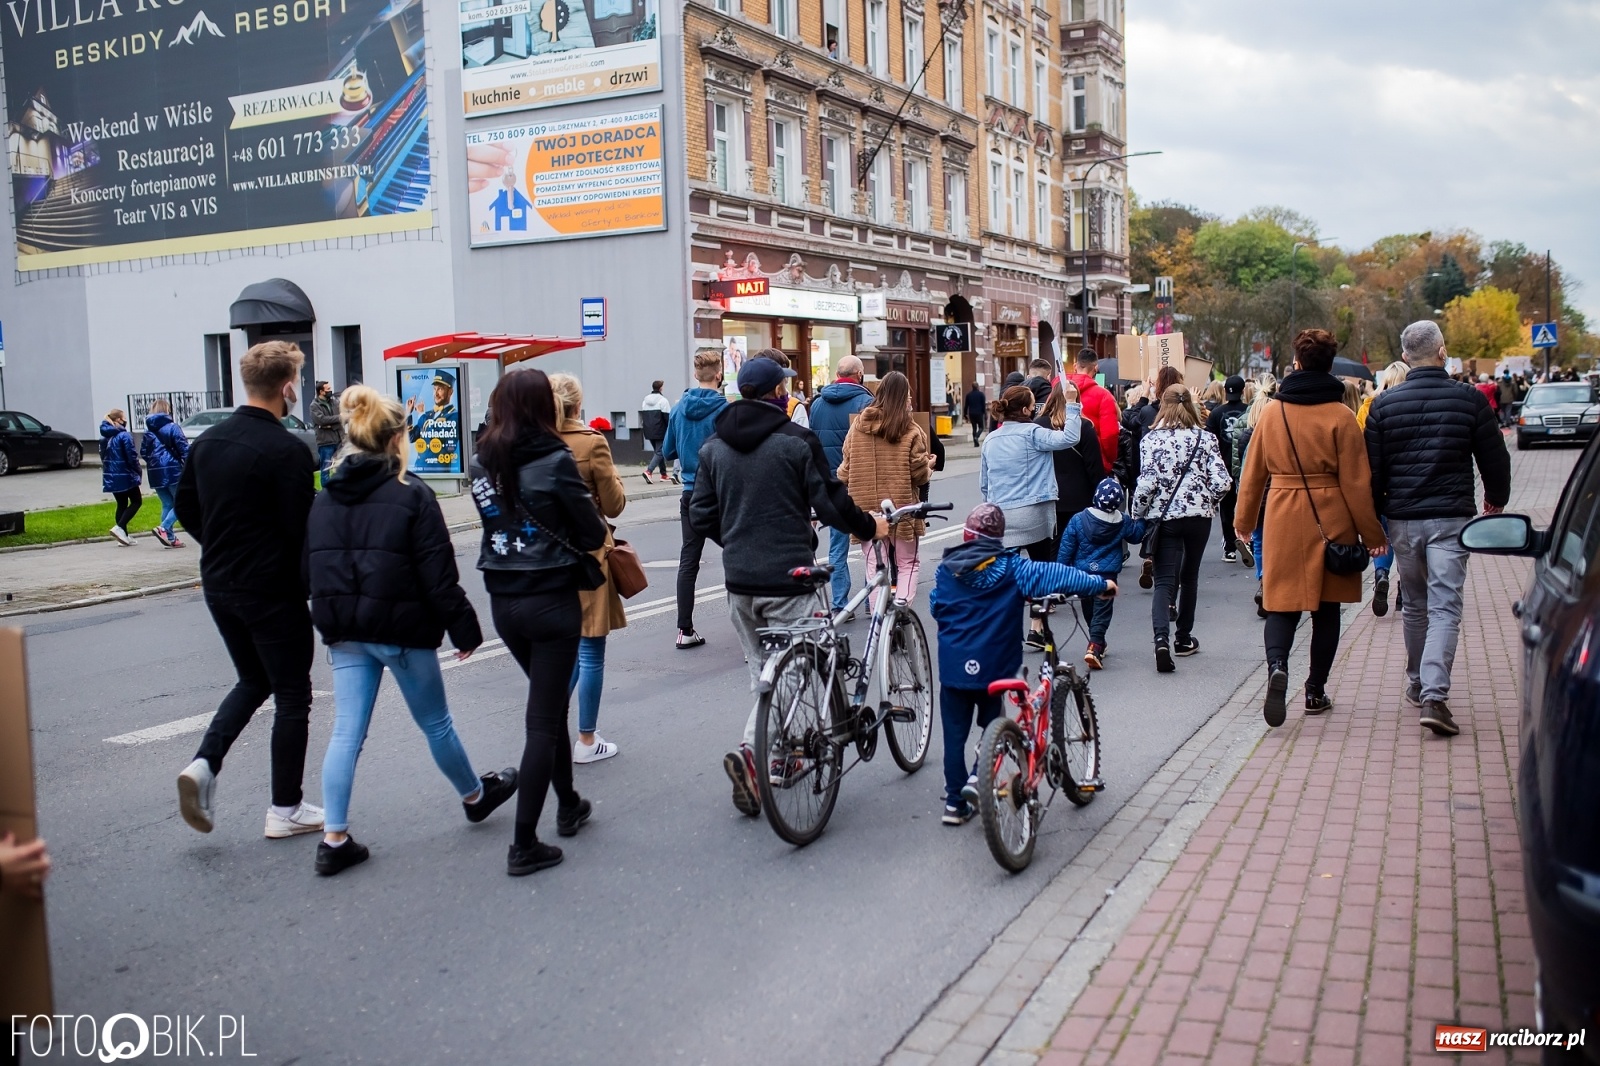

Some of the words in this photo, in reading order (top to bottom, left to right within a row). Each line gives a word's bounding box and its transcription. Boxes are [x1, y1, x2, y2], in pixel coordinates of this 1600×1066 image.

[7, 0, 123, 38] VILLA
[486, 8, 498, 18] 502
[500, 6, 513, 15] 633
[514, 4, 528, 13] 894
[55, 29, 163, 69] BESKIDY
[472, 87, 521, 106] kuchnie
[543, 76, 586, 96] meble
[610, 67, 648, 85] drzwi
[243, 90, 334, 117] REZERWACJA
[624, 112, 657, 121] RACIBÓRZ
[67, 112, 139, 144] Weekend
[144, 115, 158, 132] w
[164, 100, 212, 128] Wiśle
[467, 135, 484, 144] TEL.
[488, 132, 504, 141] 730
[508, 128, 525, 138] 809
[529, 126, 546, 136] 809
[232, 147, 252, 163] +48
[258, 136, 286, 160] 601
[293, 130, 323, 155] 773
[330, 125, 360, 150] 333
[535, 134, 576, 151] TWÓJ
[581, 125, 656, 146] DORADCA
[117, 137, 214, 171] Restauracja
[551, 145, 645, 168] HIPOTECZNY
[232, 164, 374, 192] www.VILLARUBINSTEIN.PL
[536, 171, 573, 181] POLICZYMY
[576, 166, 614, 176] ZDOLNOŚĆ
[536, 183, 575, 193] POMOŻEMY
[577, 178, 612, 188] WYPEŁNIĆ
[615, 174, 660, 184] DOKUMENTY
[70, 185, 126, 205] Koncerty
[130, 172, 216, 197] fortepianowe
[537, 196, 581, 206] ZNAJDZIEMY
[583, 191, 630, 201] ODPOWIEDNI
[633, 187, 660, 196] KREDYT
[114, 208, 146, 225] Teatr
[150, 201, 175, 220] VIS
[180, 204, 187, 218] a
[190, 196, 218, 216] VIS
[736, 281, 764, 294] NAJT
[420, 429, 457, 438] wsiadać!
[428, 419, 457, 430] Proszę
